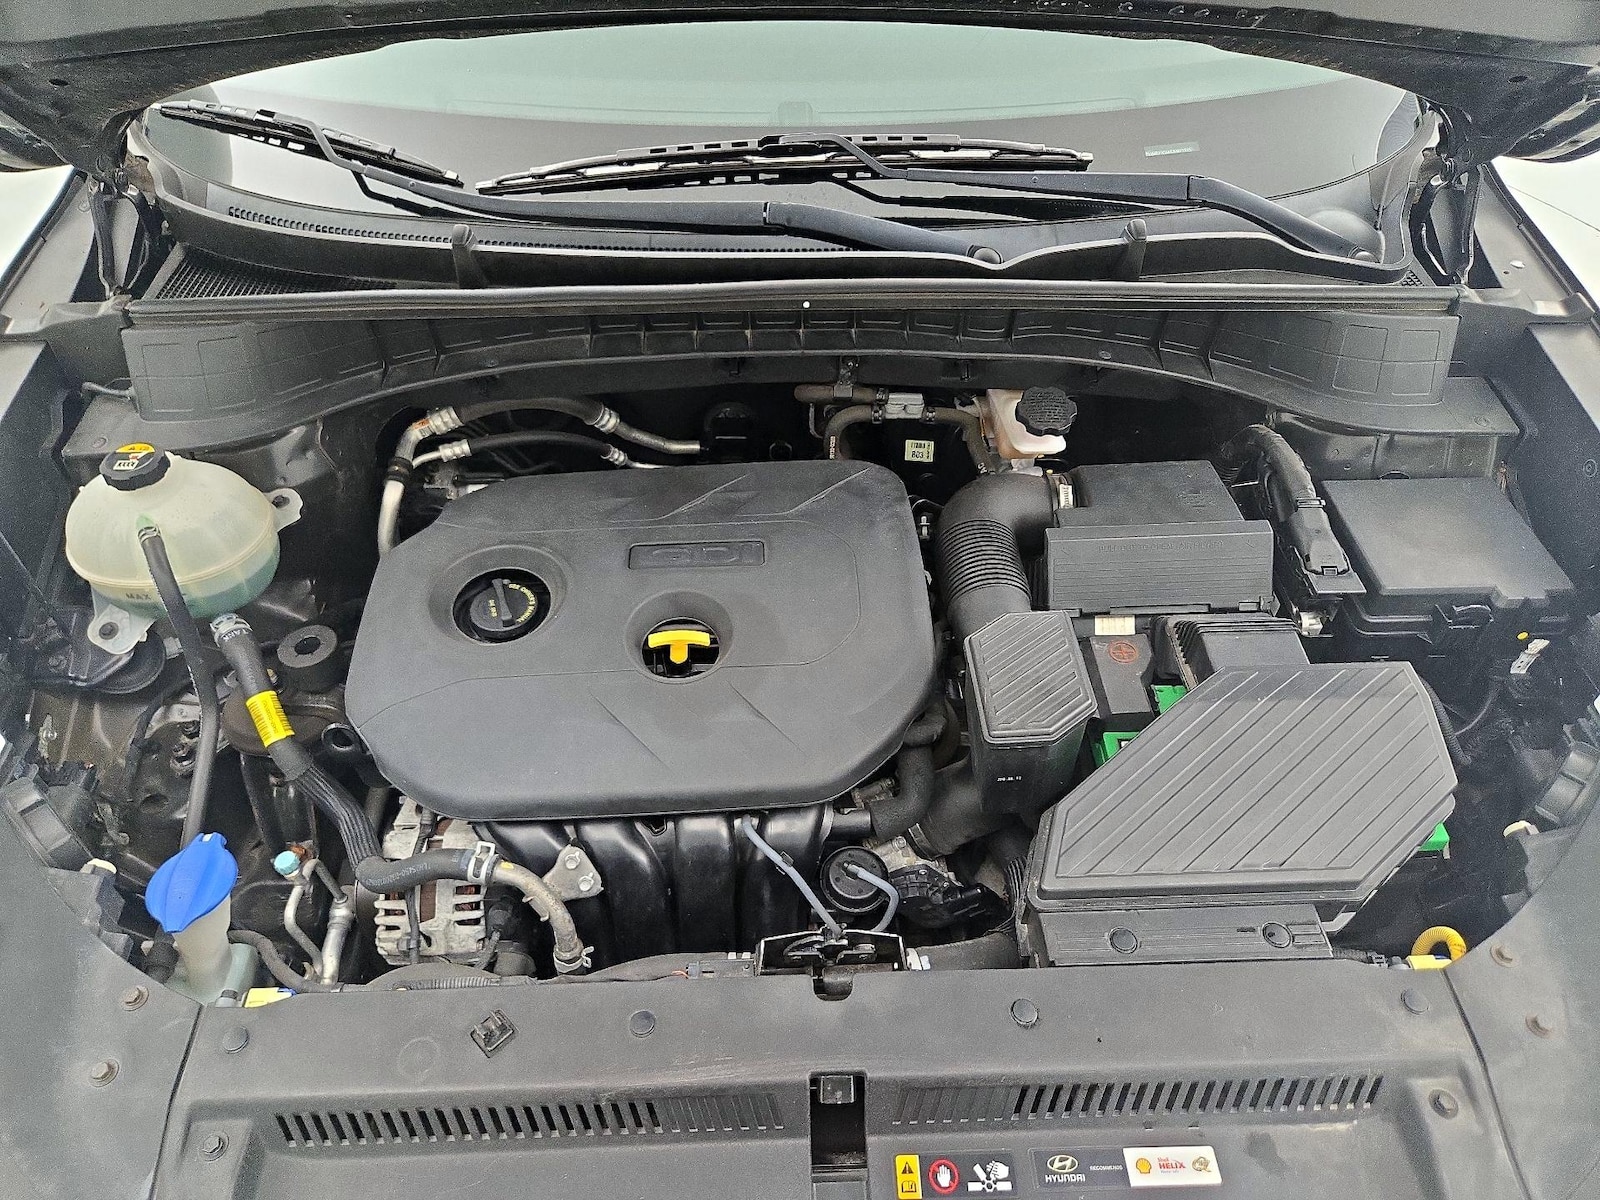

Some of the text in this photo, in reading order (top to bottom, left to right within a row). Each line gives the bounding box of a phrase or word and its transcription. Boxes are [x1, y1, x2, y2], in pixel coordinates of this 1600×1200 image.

[126, 592, 151, 600] MAX
[1158, 1160, 1186, 1170] HELIX
[1045, 1173, 1086, 1183] HYUNDAI
